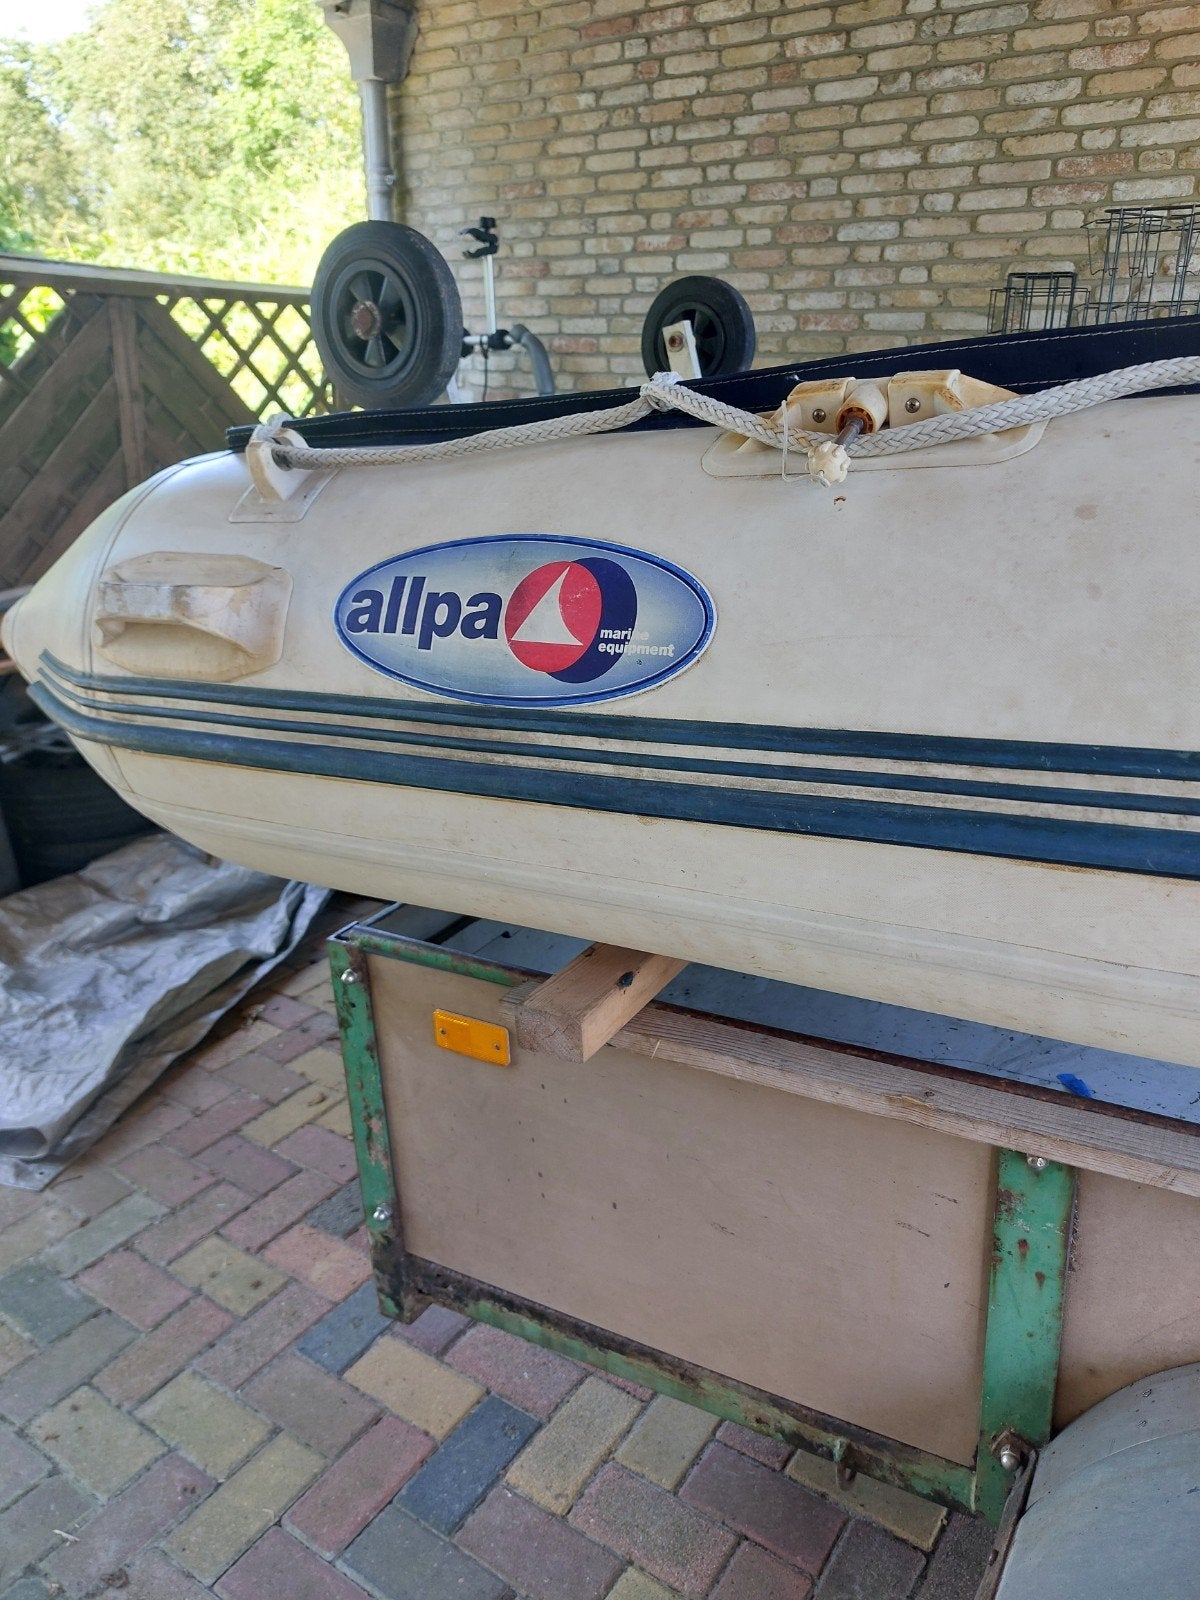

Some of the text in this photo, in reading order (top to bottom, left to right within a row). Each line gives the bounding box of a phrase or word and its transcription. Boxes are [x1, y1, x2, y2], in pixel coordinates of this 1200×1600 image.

[346, 576, 503, 650] allpa
[600, 627, 650, 640] marie
[598, 641, 675, 657] equipment
